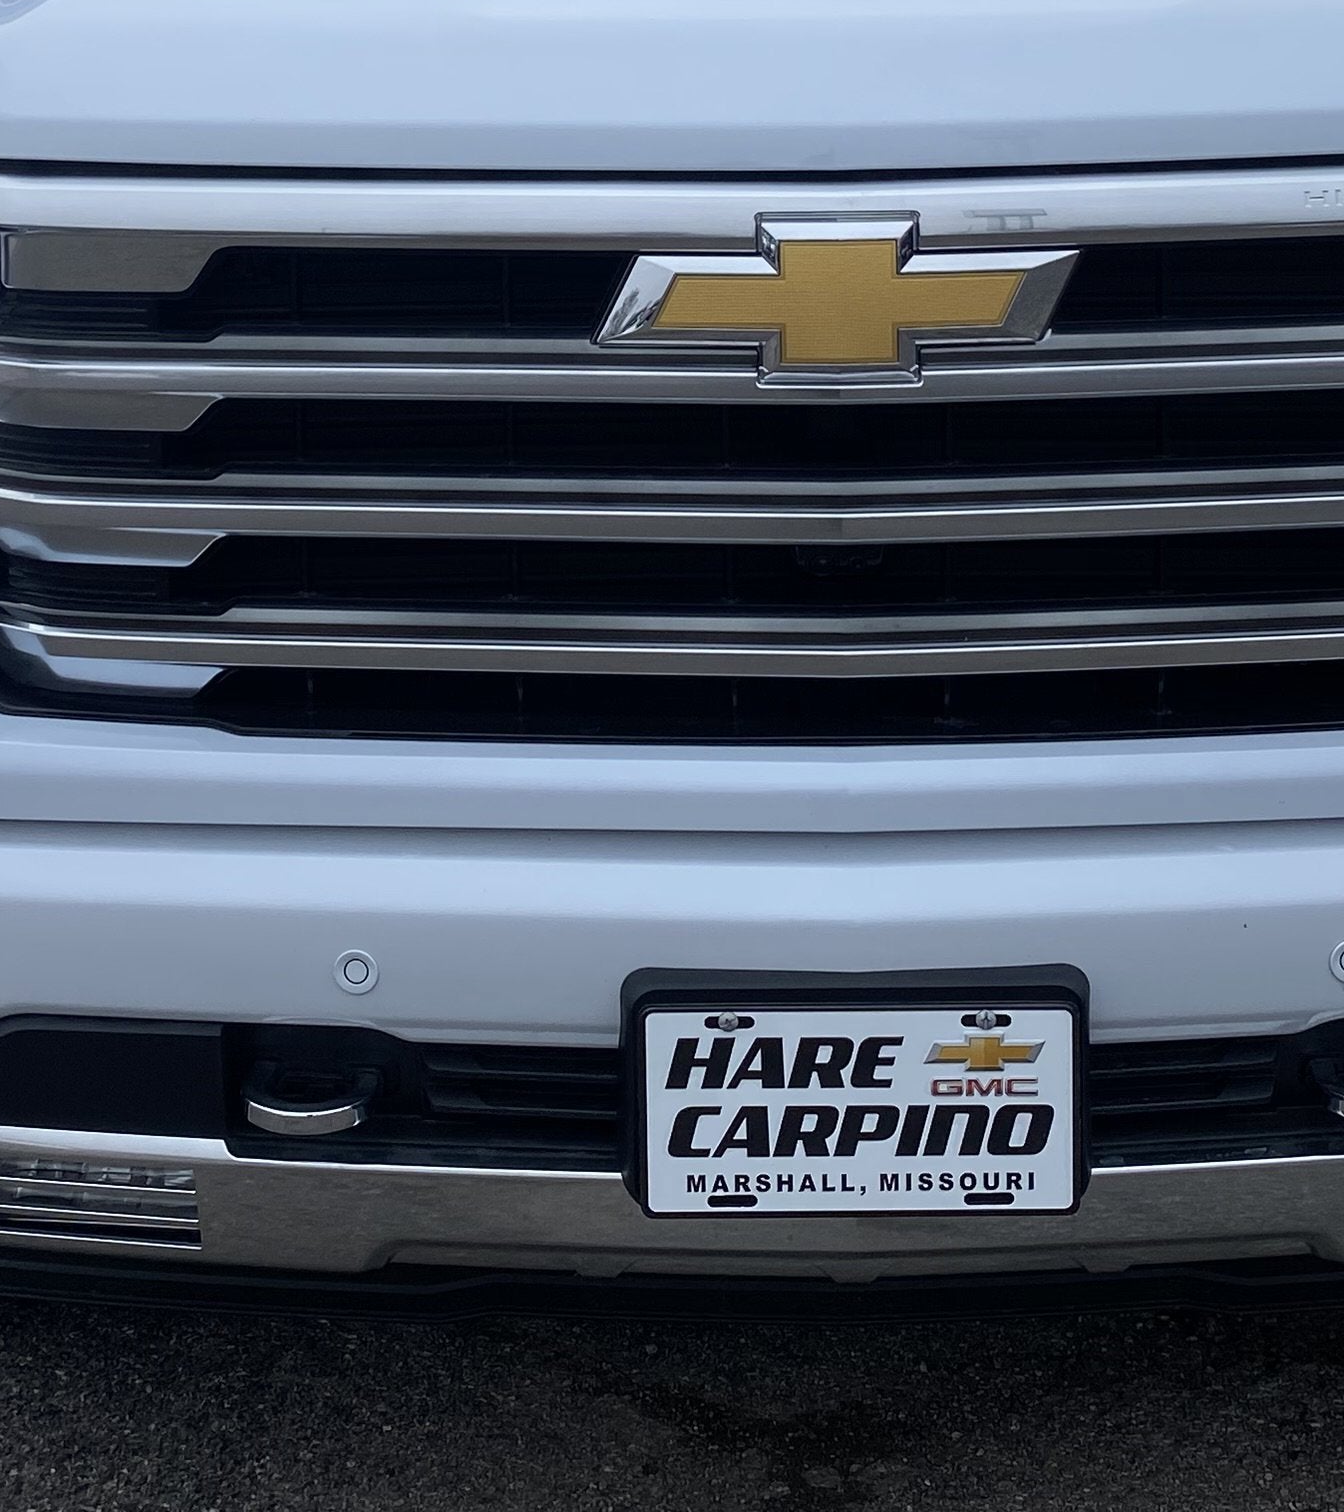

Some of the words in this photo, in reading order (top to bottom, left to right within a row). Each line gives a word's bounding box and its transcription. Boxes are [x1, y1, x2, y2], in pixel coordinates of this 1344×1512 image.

[664, 1035, 905, 1090] HARE
[931, 1076, 1039, 1097] GMC
[667, 1103, 1055, 1158] CARPINO
[686, 1173, 867, 1196] MARSHALL,
[879, 1171, 1036, 1192] MISSOURI
